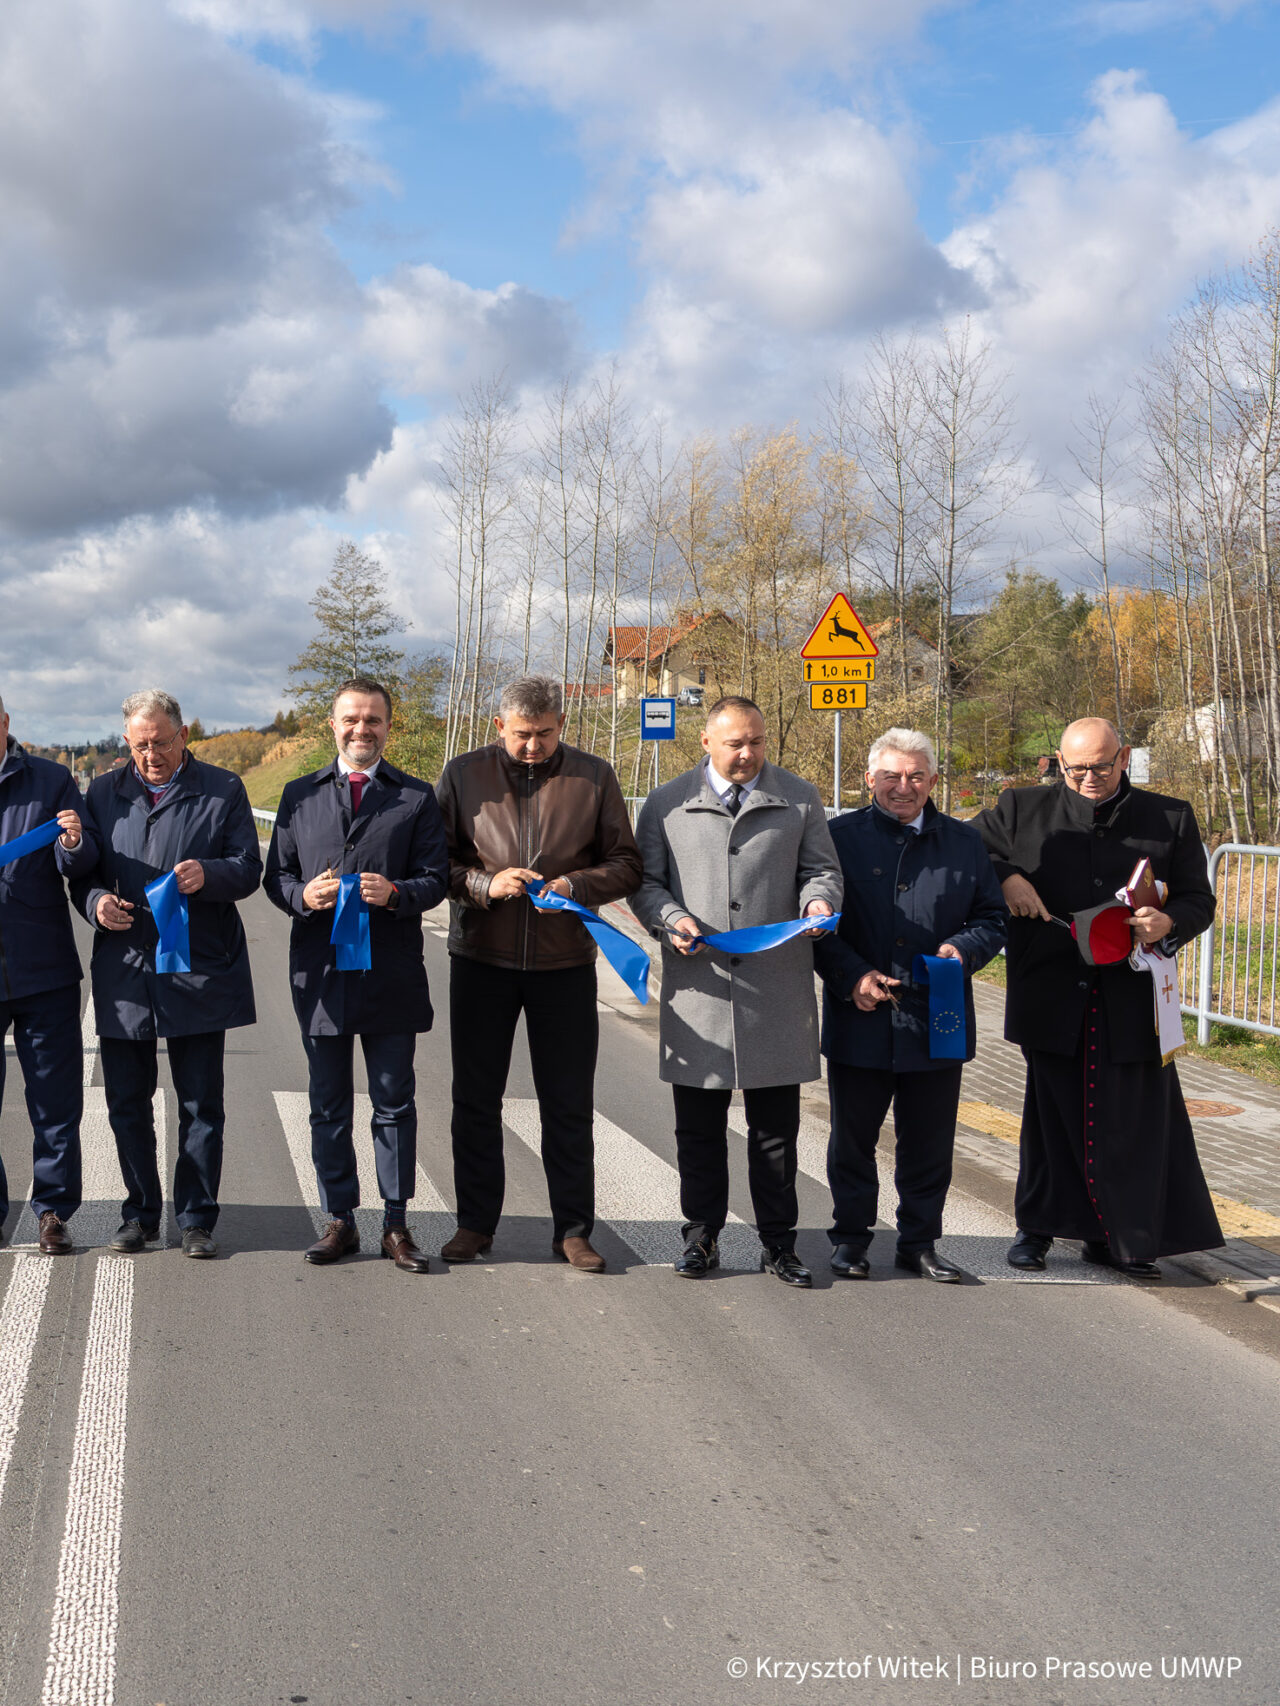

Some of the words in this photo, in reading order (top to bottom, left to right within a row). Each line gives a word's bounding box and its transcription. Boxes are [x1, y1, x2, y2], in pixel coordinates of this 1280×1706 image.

[821, 664, 838, 678] 1,0
[843, 666, 862, 677] km
[822, 688, 856, 704] 881
